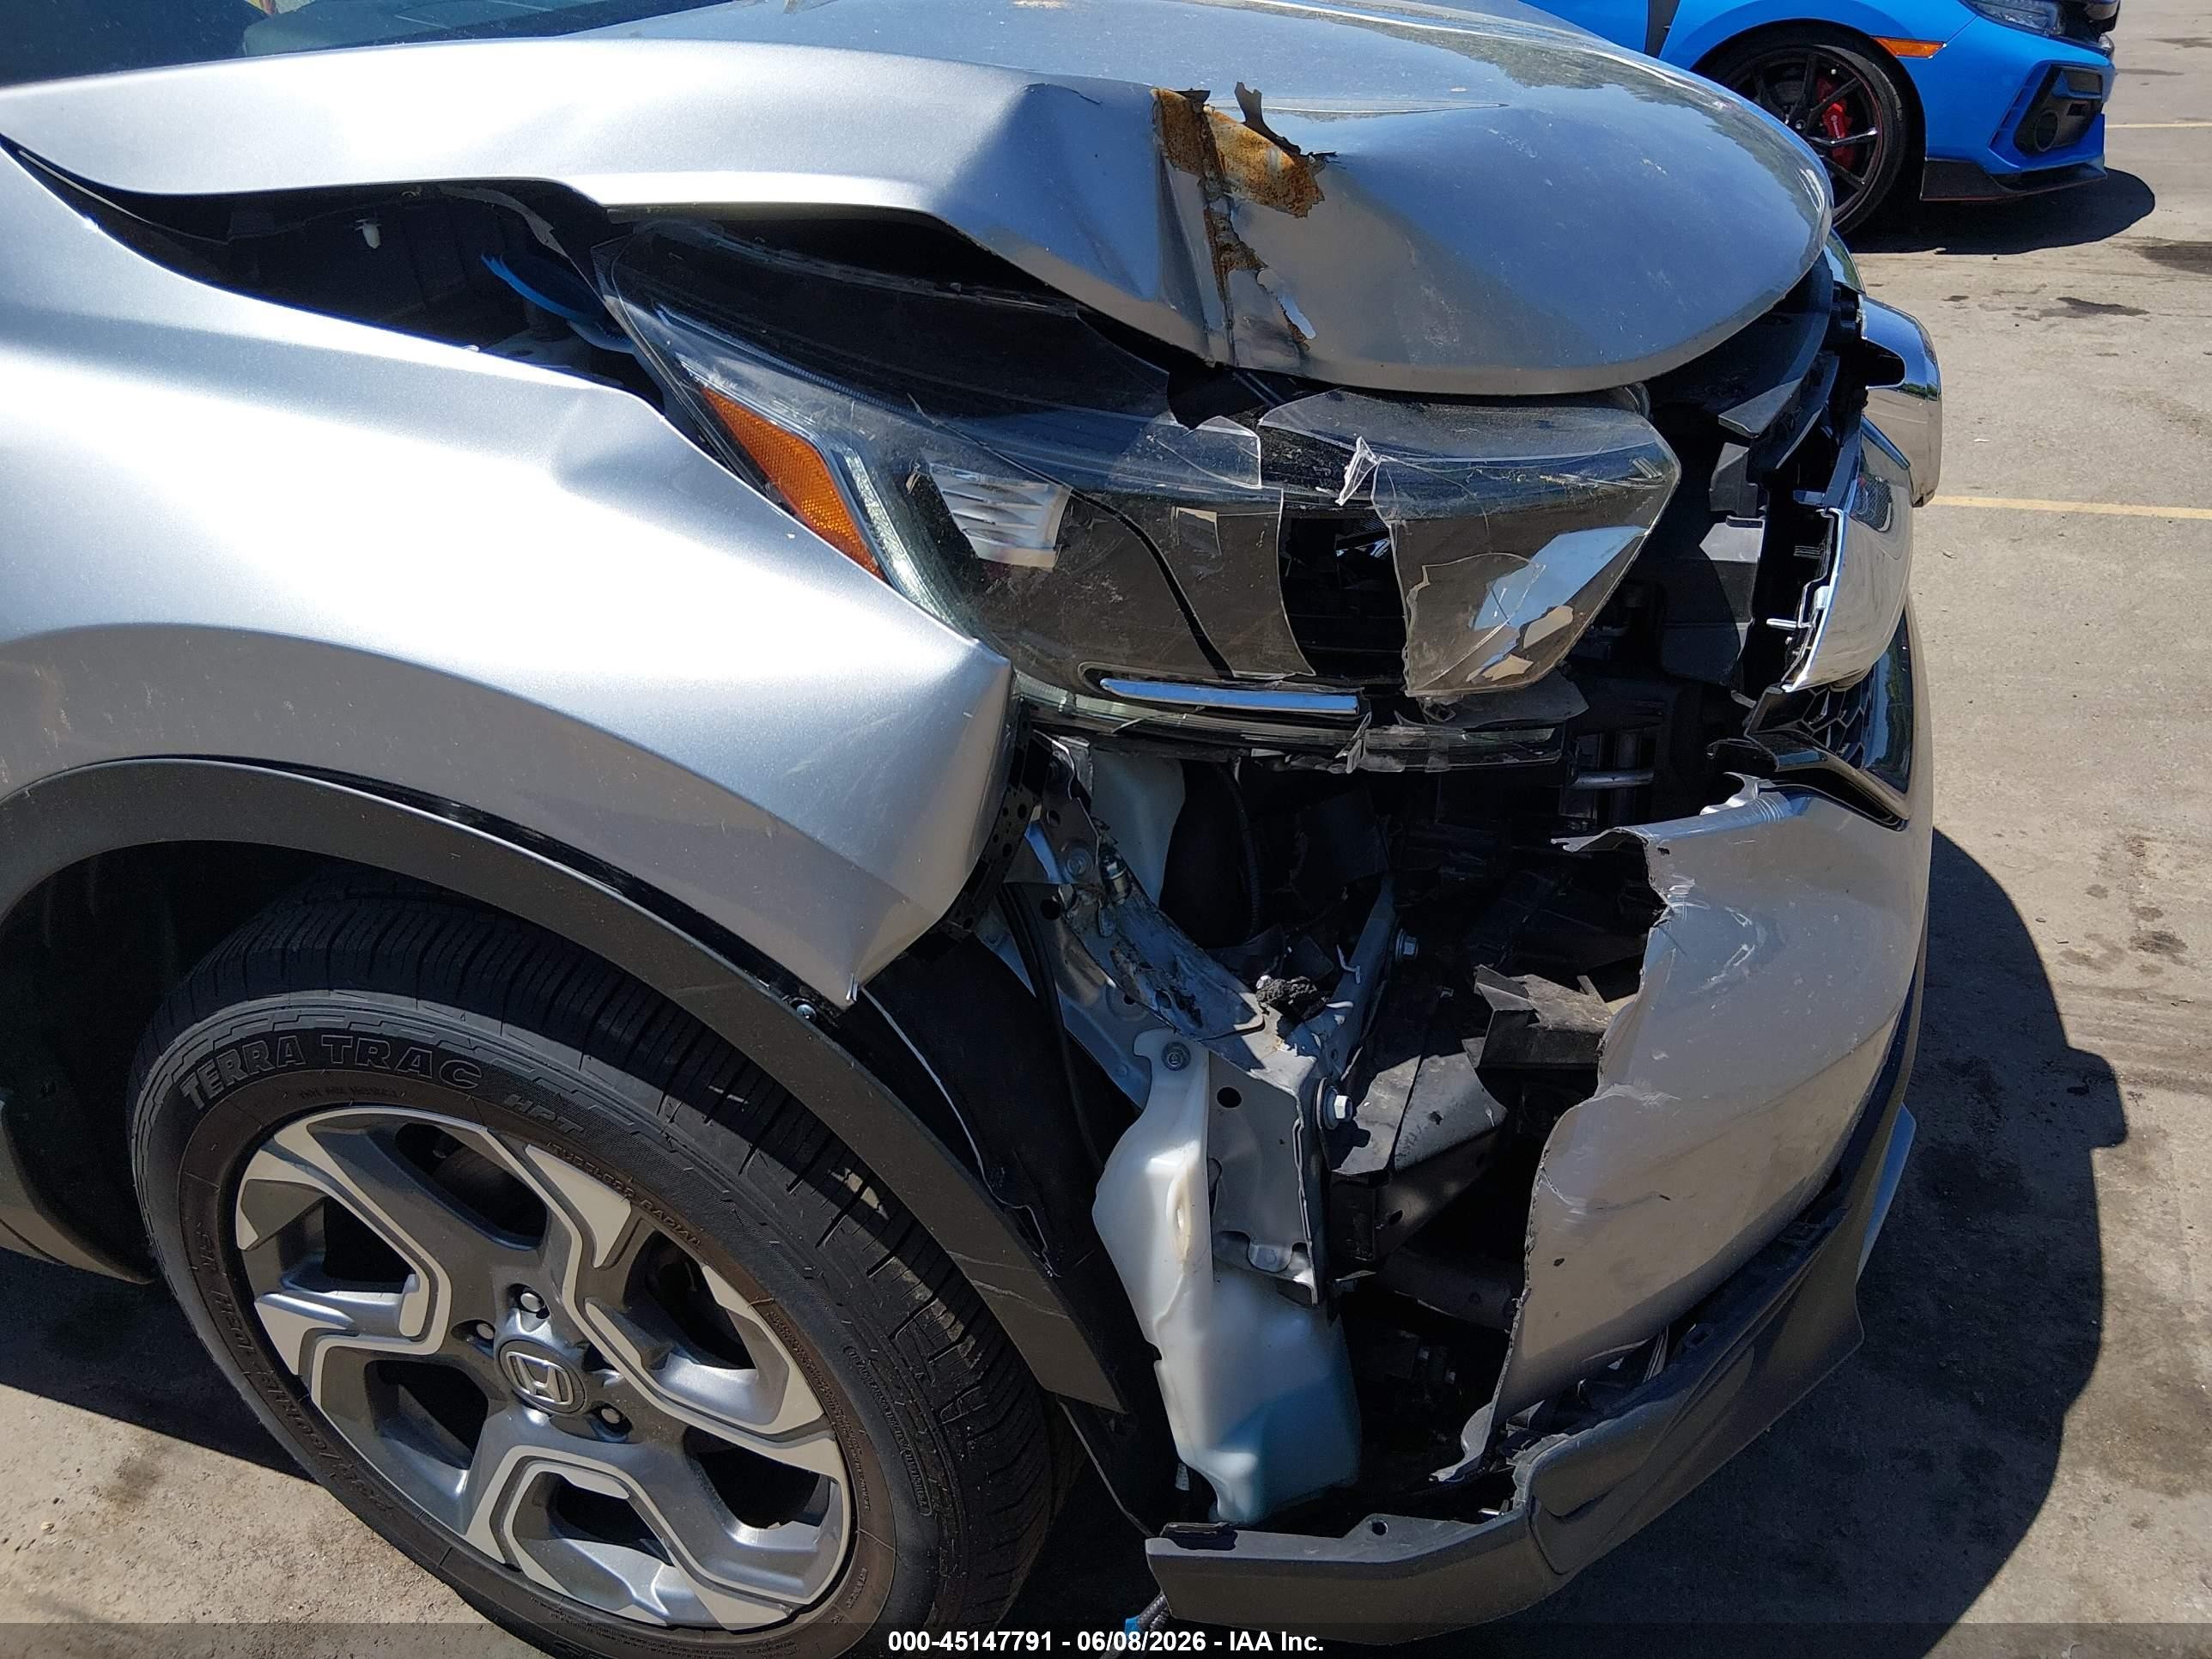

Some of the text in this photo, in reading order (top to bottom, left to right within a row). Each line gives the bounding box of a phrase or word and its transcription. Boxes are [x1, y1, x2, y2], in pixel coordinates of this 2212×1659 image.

[179, 1034, 585, 1135] TERRA TRAC HPT
